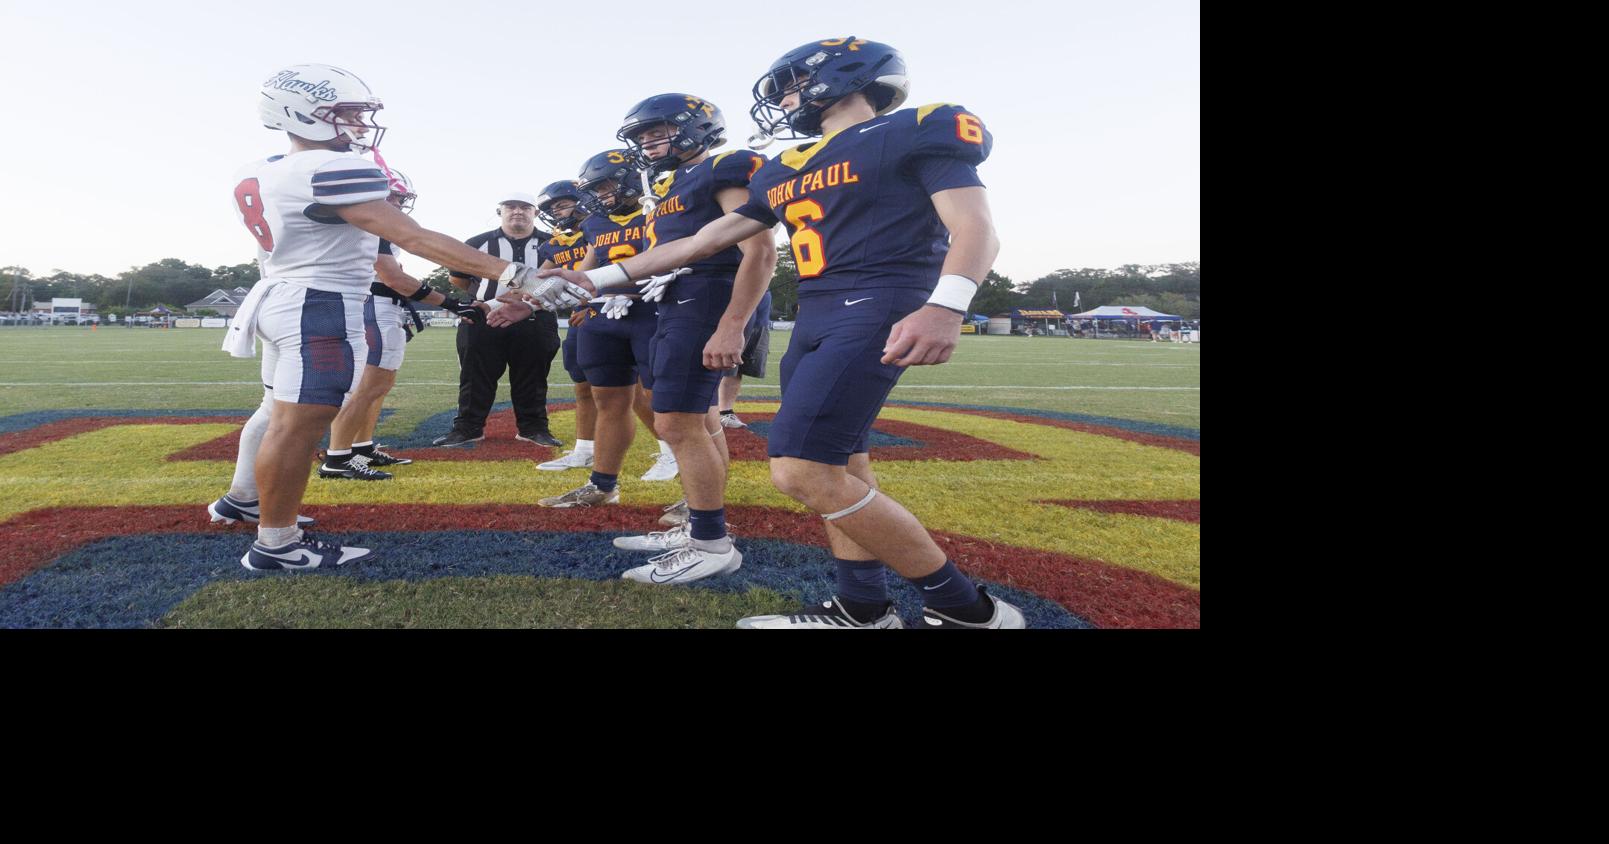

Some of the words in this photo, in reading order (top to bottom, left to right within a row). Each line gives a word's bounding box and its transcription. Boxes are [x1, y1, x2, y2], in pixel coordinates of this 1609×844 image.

[263, 70, 338, 104] Hawks
[954, 111, 984, 144] 6
[766, 178, 796, 210] JOHN
[800, 161, 859, 194] PAUL
[234, 177, 275, 252] 8
[593, 230, 621, 248] JOHN
[624, 225, 646, 241] PA
[785, 198, 827, 278] 6
